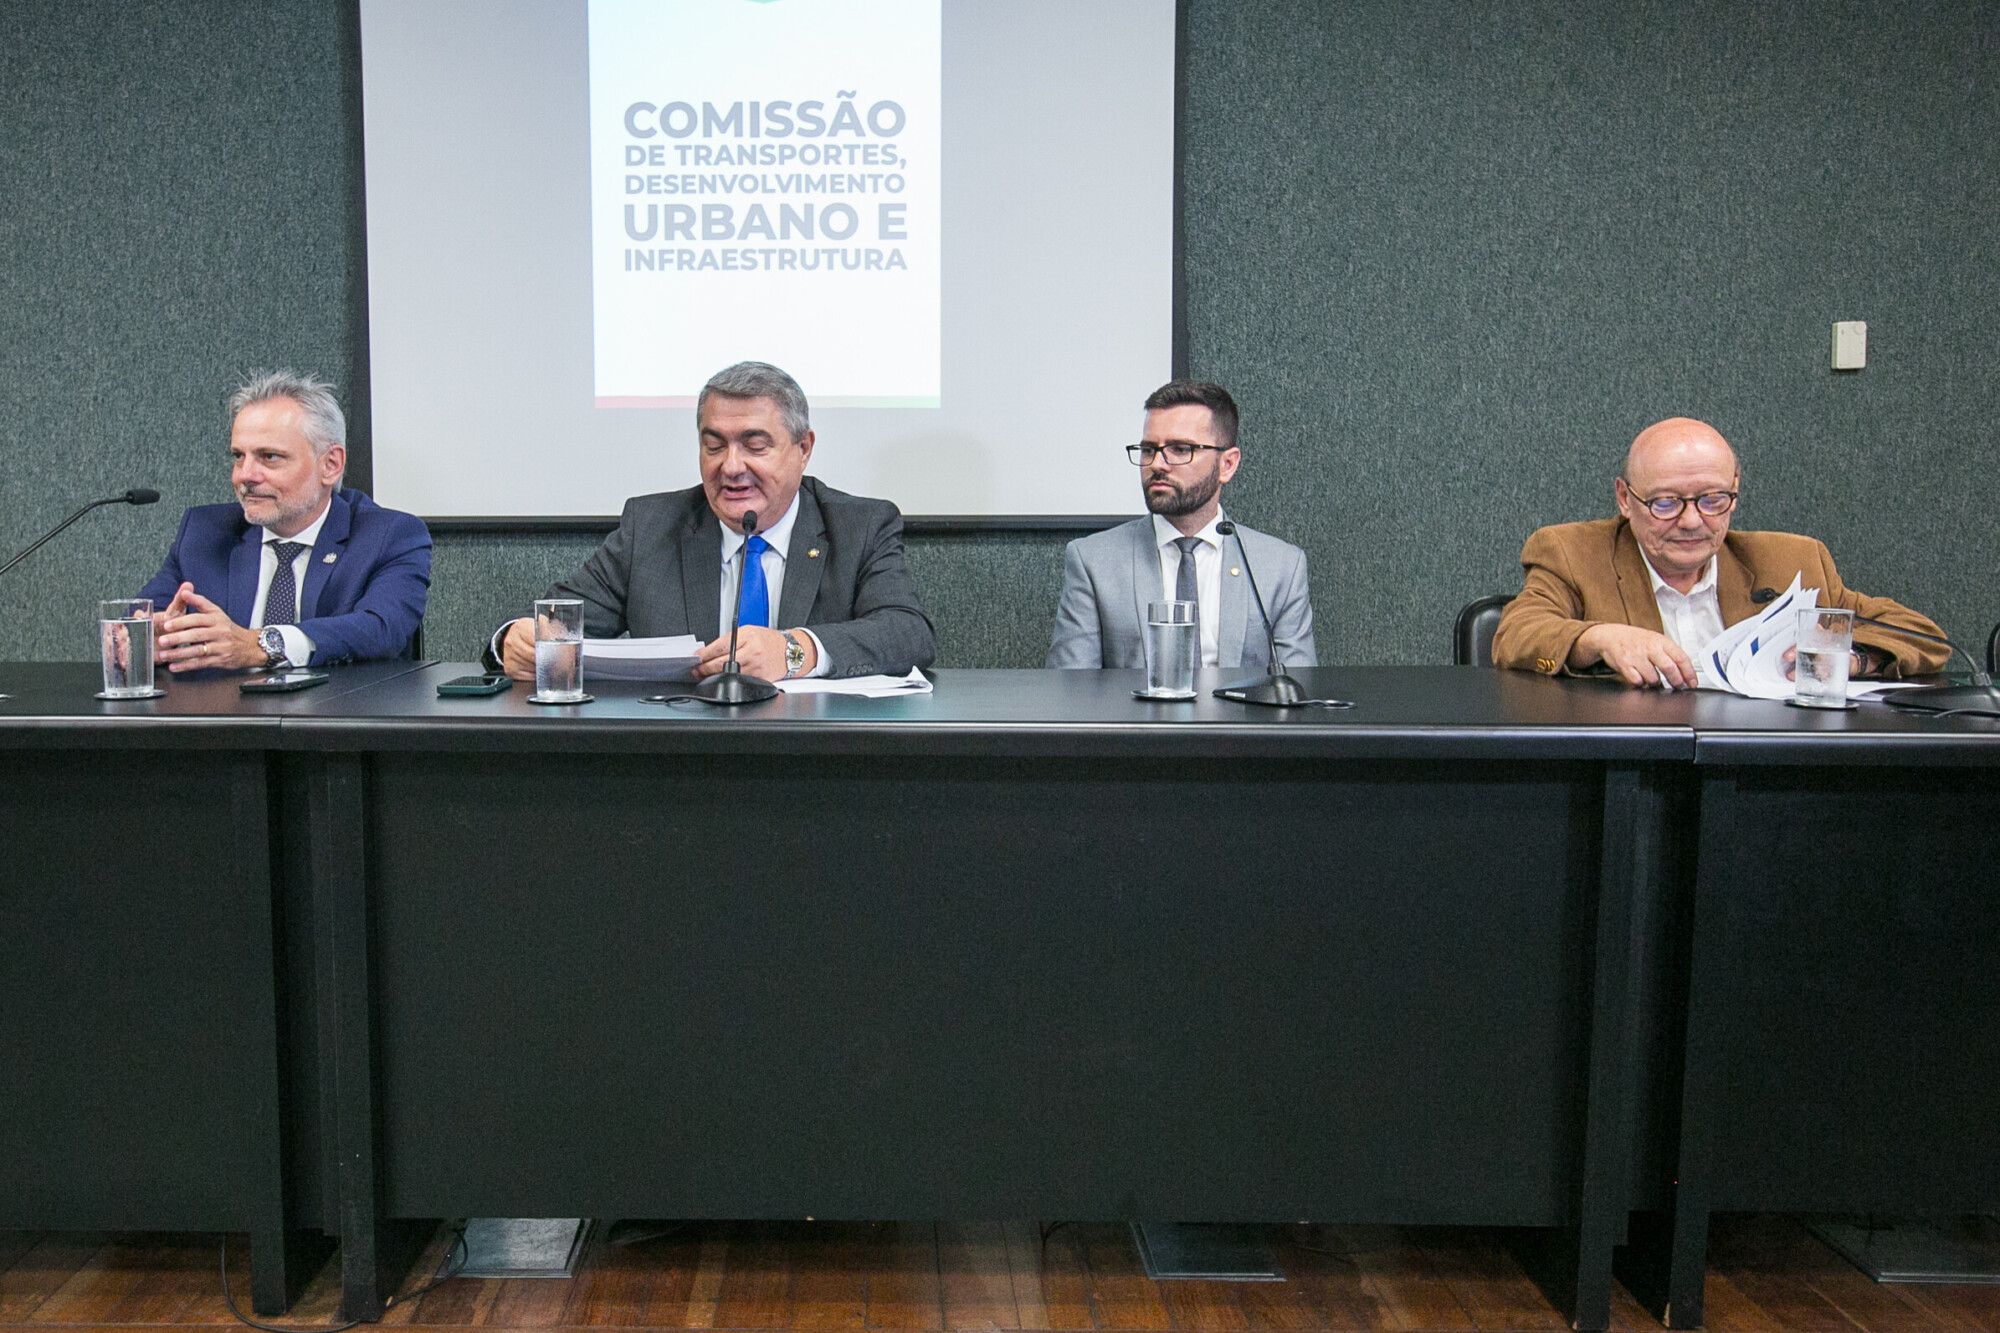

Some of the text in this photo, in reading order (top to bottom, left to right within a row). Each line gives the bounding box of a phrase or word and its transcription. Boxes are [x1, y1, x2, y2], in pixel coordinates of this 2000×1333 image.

[624, 90, 906, 138] COMISSÃO
[625, 144, 907, 169] DE TRANSPORTES,
[625, 174, 905, 194] DESENVOLVIMENTO
[624, 203, 908, 241] URBANO E
[624, 248, 908, 271] INFRAESTRUTURA
